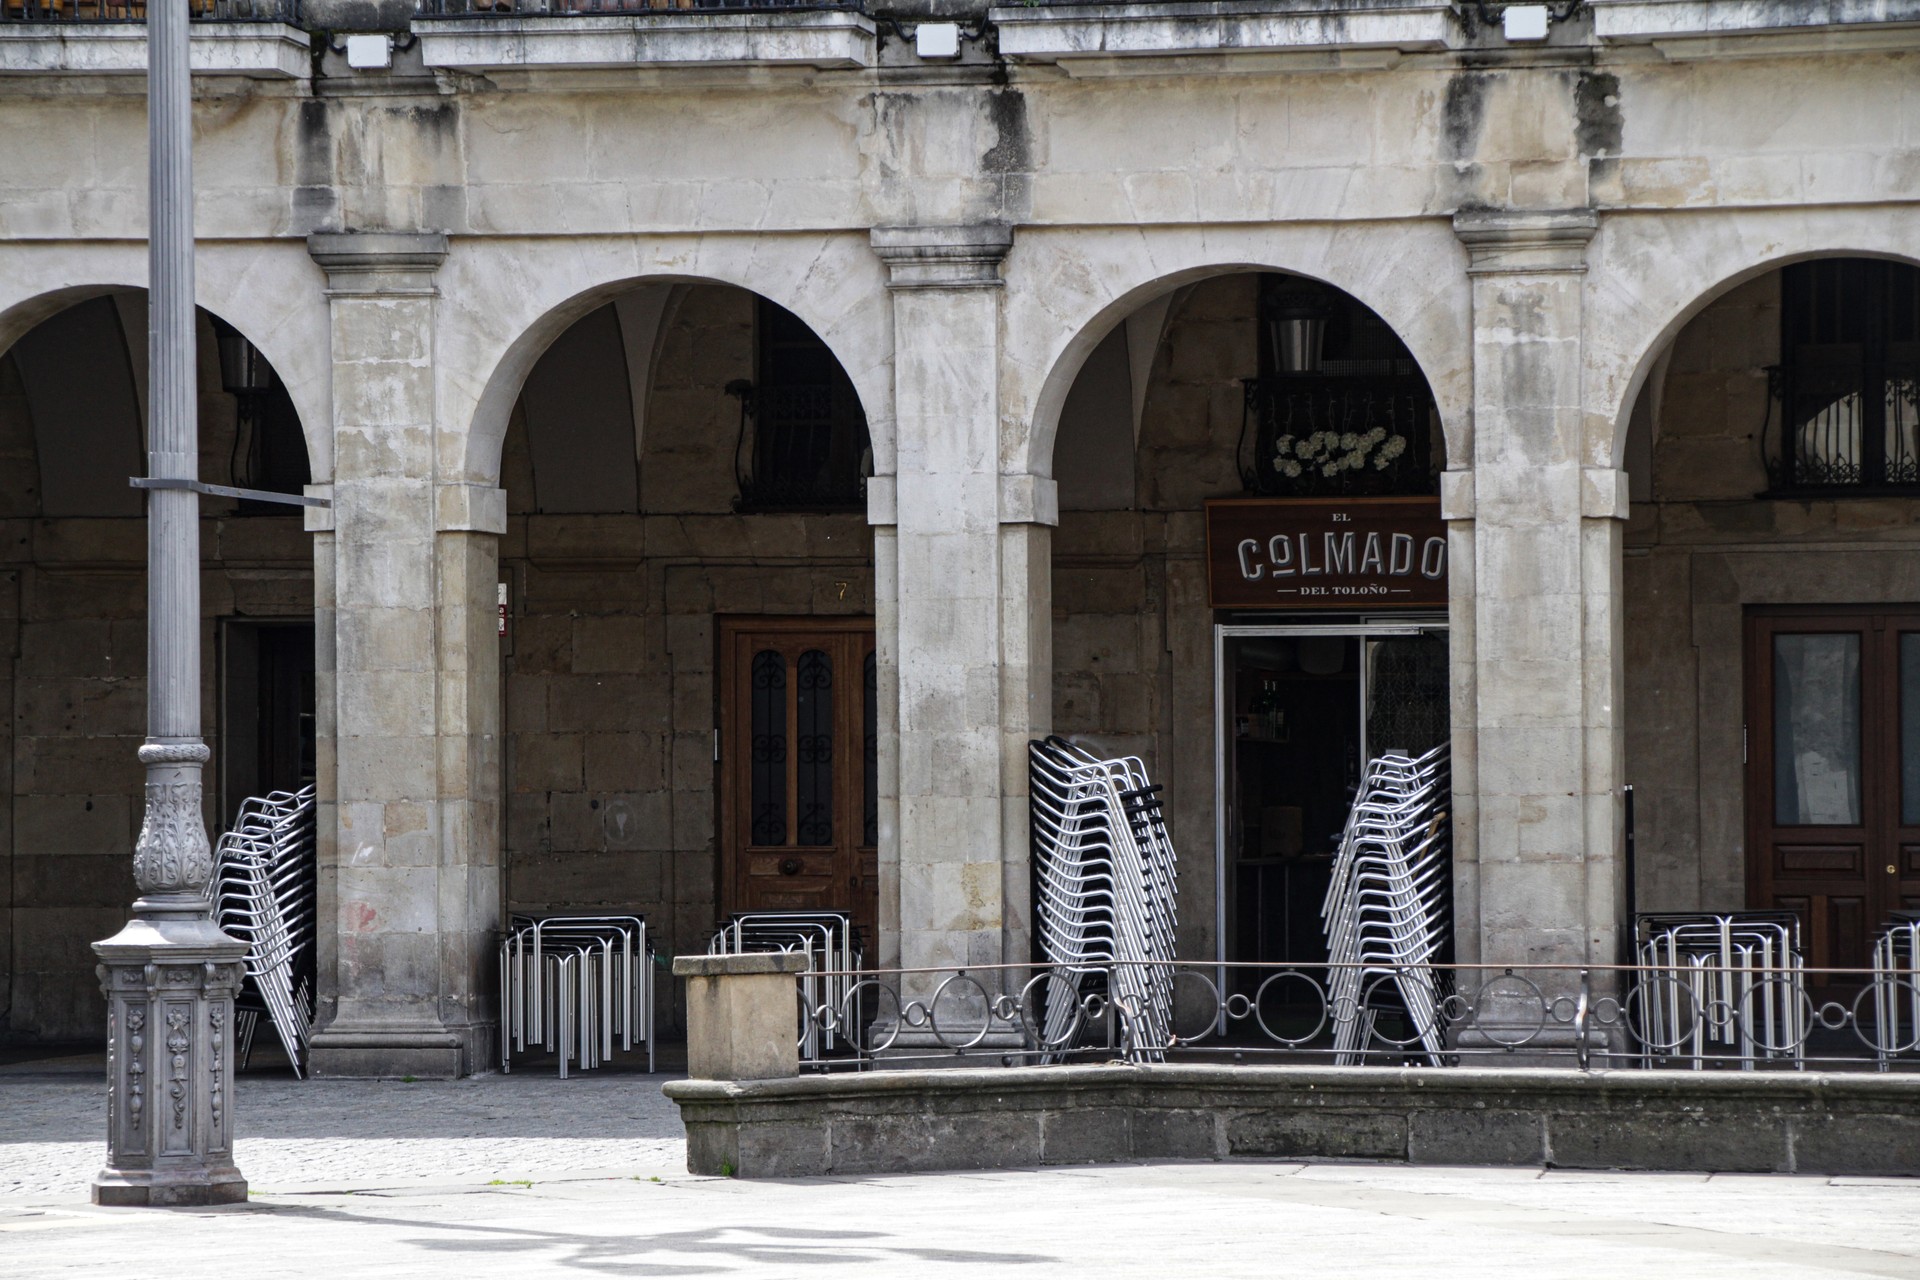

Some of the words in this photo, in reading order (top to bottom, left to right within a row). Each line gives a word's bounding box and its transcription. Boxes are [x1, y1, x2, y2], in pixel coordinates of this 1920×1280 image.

[1332, 513, 1351, 522] EL
[1237, 531, 1447, 581] COLMADO
[835, 582, 847, 600] 7
[1300, 586, 1329, 595] DEL
[1332, 583, 1388, 595] TOLOÑO
